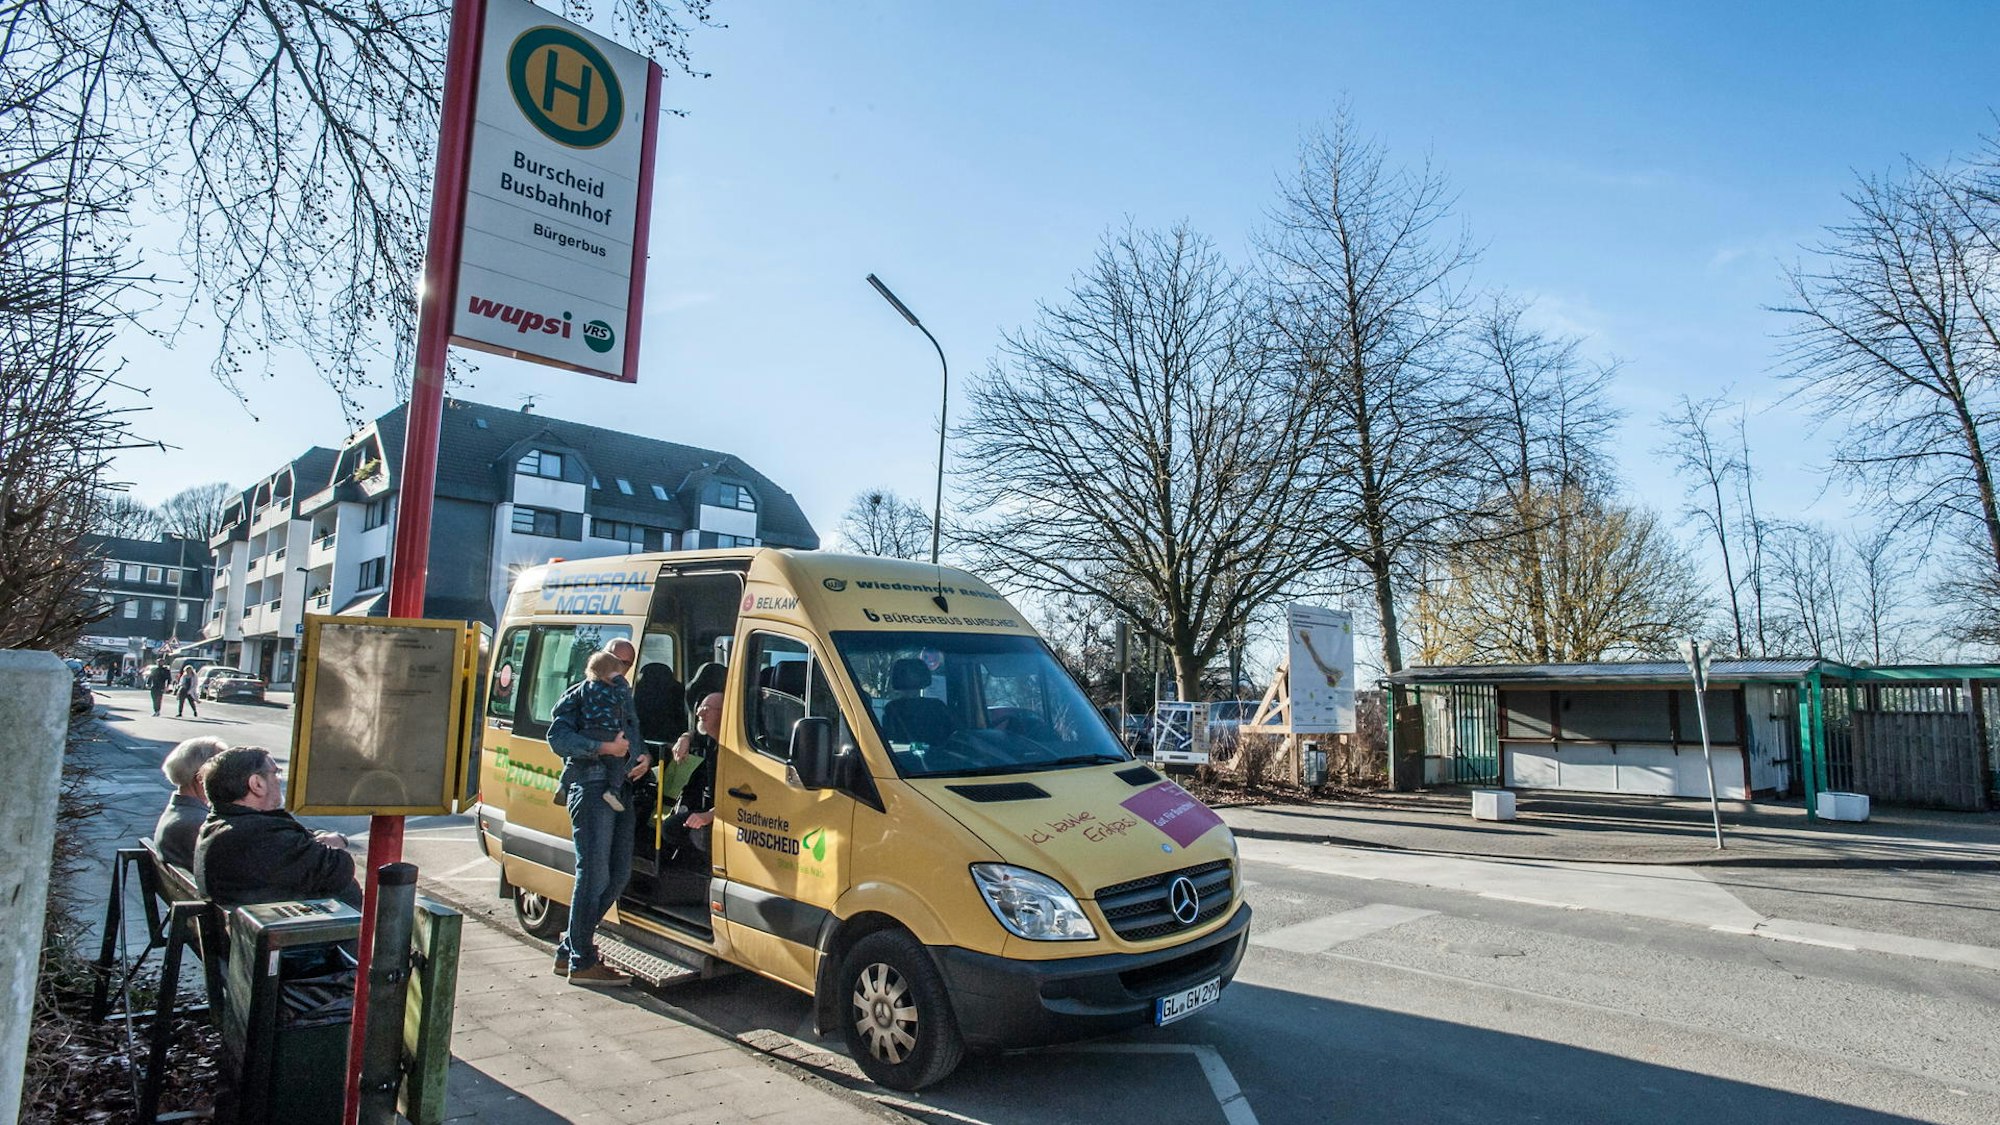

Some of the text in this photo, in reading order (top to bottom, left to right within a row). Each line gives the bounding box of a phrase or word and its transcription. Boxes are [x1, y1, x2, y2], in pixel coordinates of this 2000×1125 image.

[542, 49, 592, 126] H
[514, 150, 604, 199] Burscheid
[500, 172, 612, 226] Busbahnhof
[533, 222, 607, 257] Bürgerbus
[468, 295, 572, 339] wupsi
[583, 322, 609, 339] VRS
[561, 571, 653, 593] FEDERAL
[856, 580, 955, 595] Wiedenhoff
[555, 594, 624, 615] MOGUL
[756, 596, 800, 610] BELKAW
[882, 612, 963, 626] BÜRGERBUS
[737, 808, 789, 832] Stadtwerke
[736, 827, 800, 856] BURSCHEID
[1164, 998, 1178, 1017] GL
[1187, 989, 1200, 1009] GW
